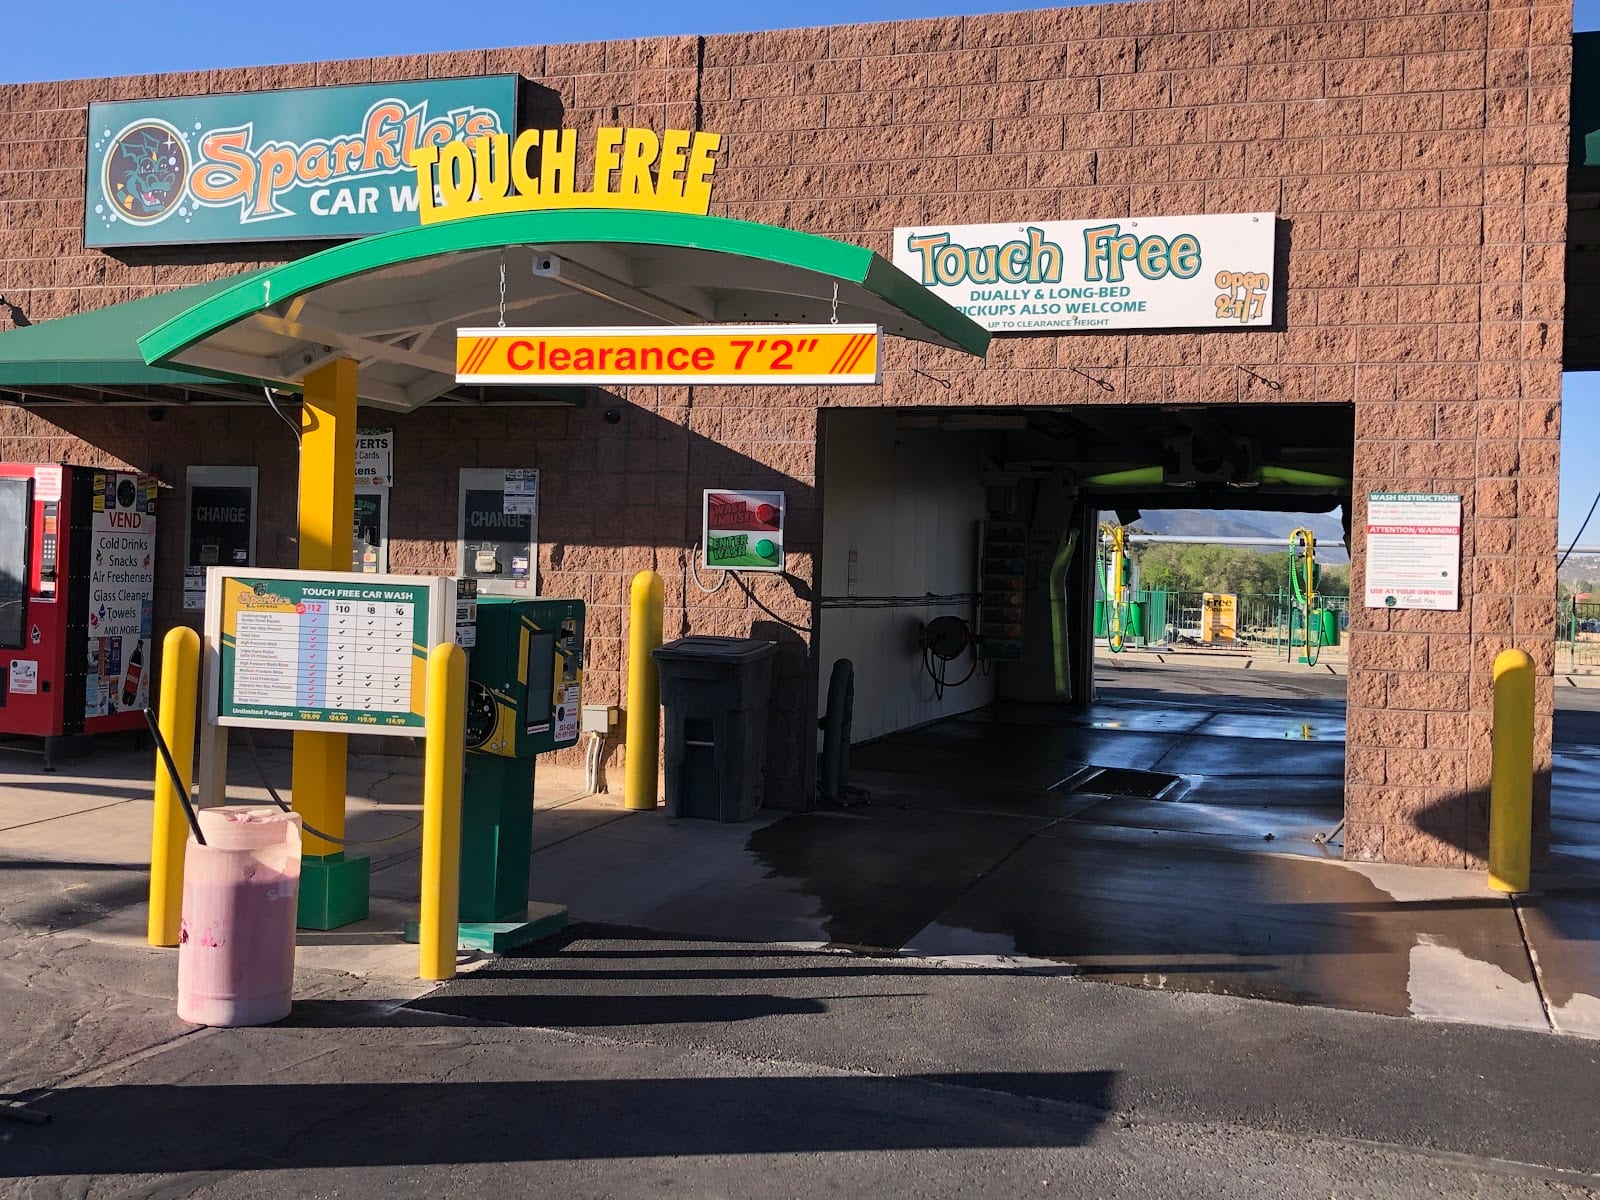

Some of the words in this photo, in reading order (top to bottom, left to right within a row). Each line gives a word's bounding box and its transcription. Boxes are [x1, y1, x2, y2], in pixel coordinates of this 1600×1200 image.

[188, 99, 502, 222] Sparkle's
[409, 129, 577, 213] TOUCH
[597, 127, 722, 200] FREE
[309, 187, 380, 216] CAR
[908, 227, 1063, 286] Touch
[1083, 224, 1202, 282] Free
[1215, 270, 1269, 300] Open
[970, 288, 1030, 301] DUALLY
[1034, 288, 1044, 300] &
[1049, 286, 1131, 299] LONG-BED
[1020, 303, 1061, 315] ALSO
[1065, 301, 1147, 314] WELCOME
[1215, 292, 1266, 323] 24/7
[988, 321, 1001, 329] UP
[1017, 319, 1072, 328] CLEARANCE
[1074, 318, 1110, 326] HEIGHT
[507, 340, 715, 371] Clearance
[355, 438, 389, 449] VERTS
[360, 451, 380, 459] Cards
[354, 467, 377, 476] ens
[109, 511, 142, 529] VEND
[197, 506, 246, 523] CHANGE
[471, 511, 525, 528] CHANGE
[1370, 526, 1458, 534] ATTENTION/WARNING
[100, 537, 120, 549] Cold
[122, 537, 148, 551] Drinks
[713, 534, 748, 549] ENTER
[713, 545, 747, 560] WASH
[109, 555, 138, 567] Snacks
[93, 571, 105, 582] Air
[107, 571, 152, 583] Fresheners
[94, 589, 116, 601] Glass
[118, 589, 149, 601] Cleaner
[302, 588, 335, 597] TOUCH
[337, 589, 360, 598] FREE
[362, 590, 382, 599] CAR
[384, 591, 413, 600] WASH
[1206, 597, 1232, 606] Free
[107, 607, 136, 619] Towels
[307, 604, 321, 612] $12
[336, 605, 350, 613] $10
[367, 606, 376, 614] $8
[395, 607, 404, 616] $6
[104, 625, 118, 636] AND
[232, 707, 263, 715] Unlimited
[263, 709, 294, 718] Packages
